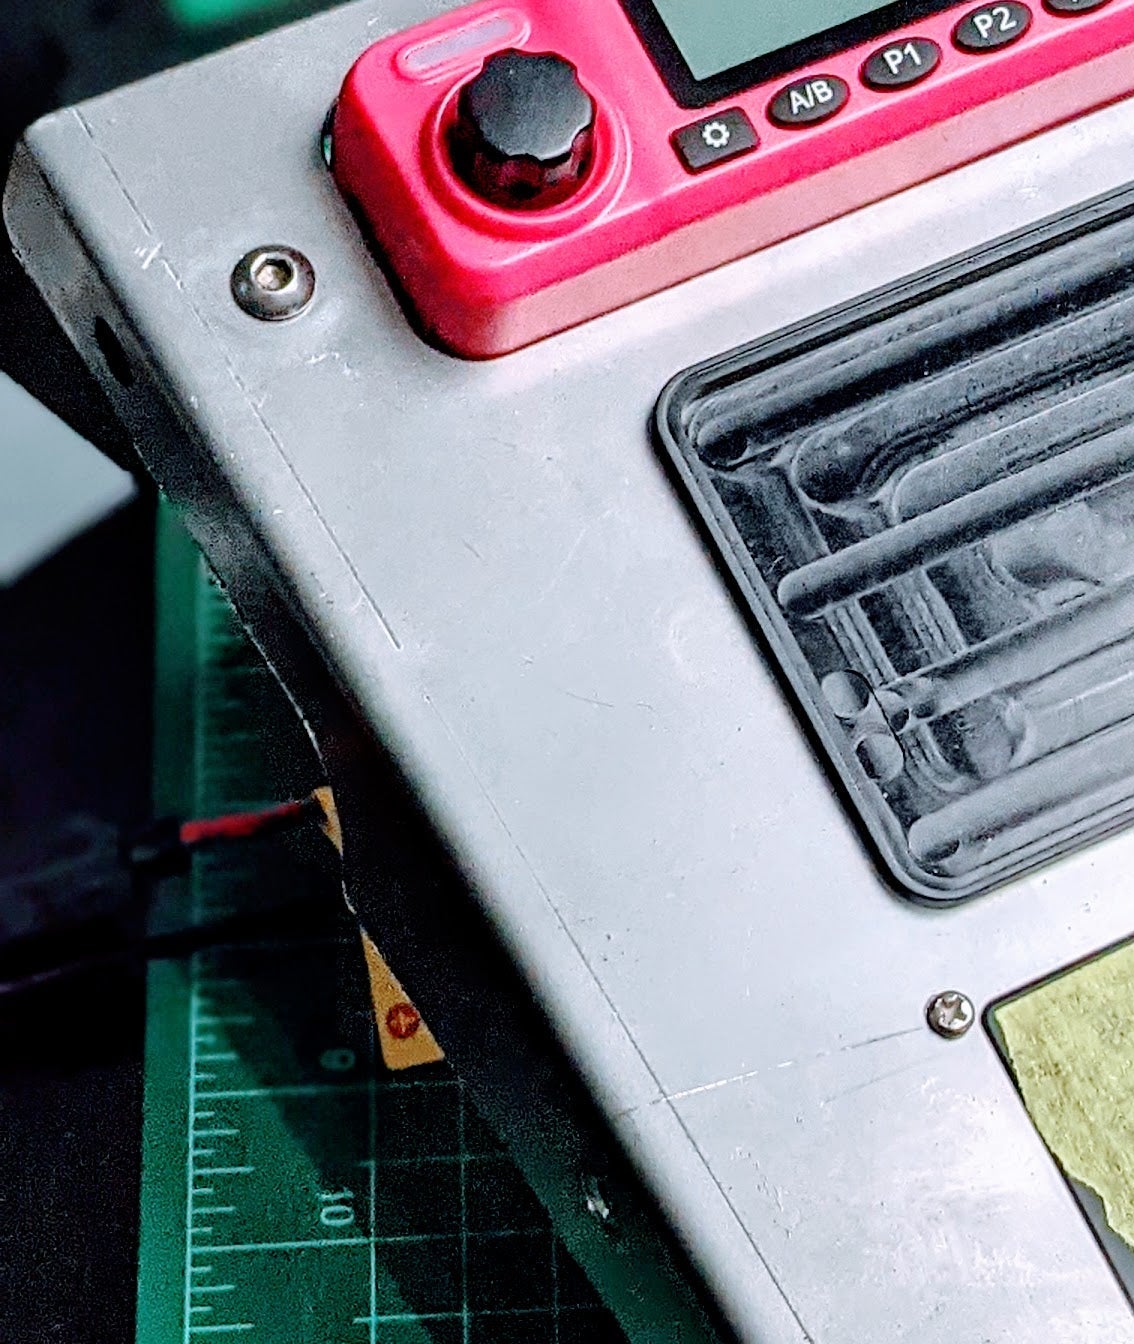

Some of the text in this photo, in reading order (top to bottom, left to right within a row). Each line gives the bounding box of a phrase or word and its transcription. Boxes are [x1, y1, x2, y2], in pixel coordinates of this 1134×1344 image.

[971, 5, 1017, 39] P2
[881, 41, 921, 75] P1
[788, 78, 834, 115] A/B
[316, 1190, 356, 1228] 10
